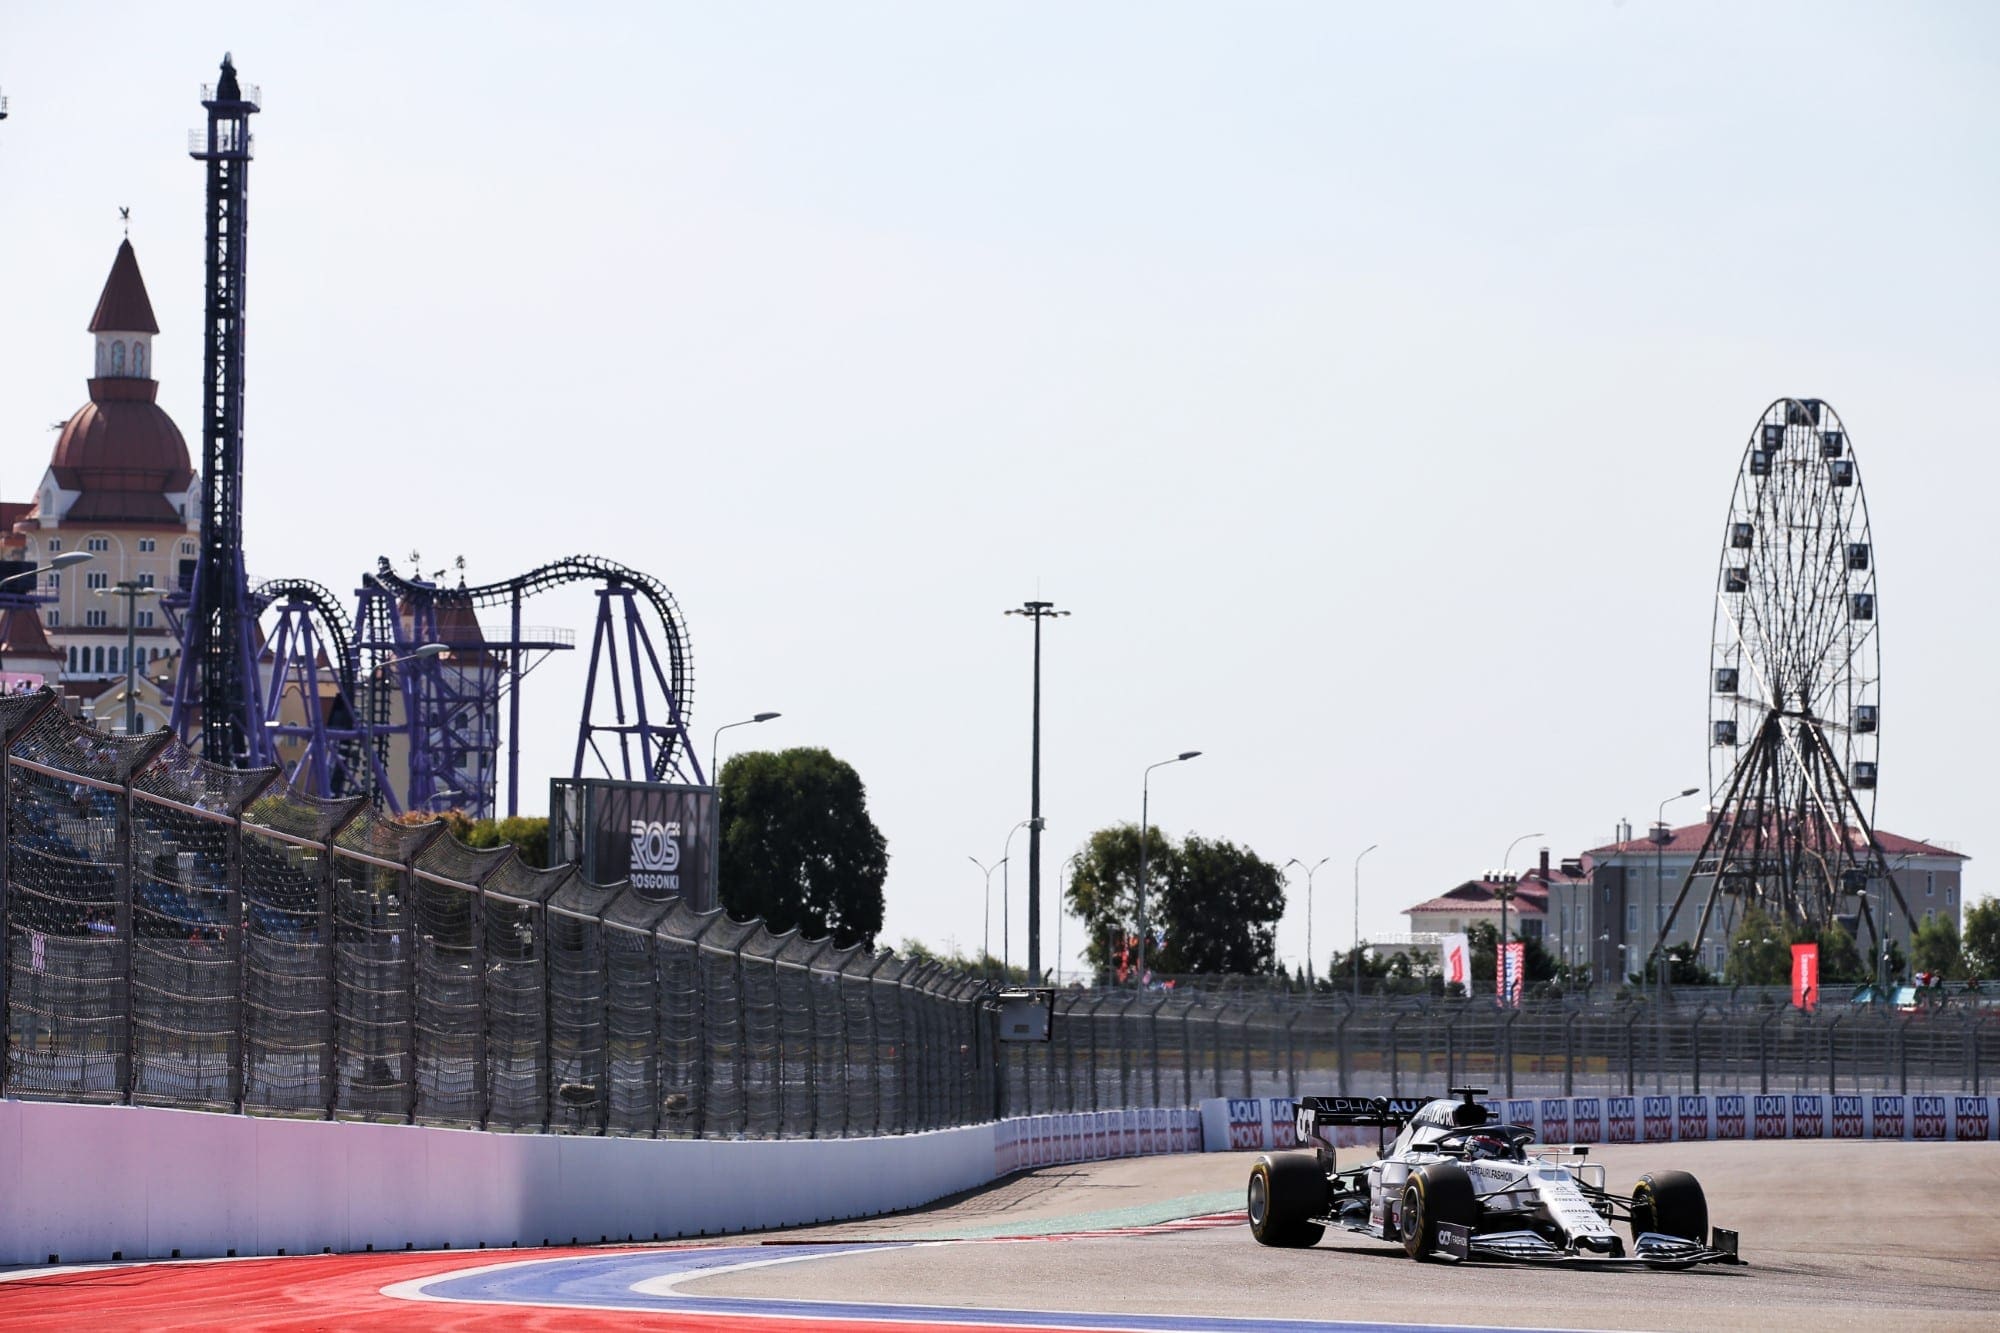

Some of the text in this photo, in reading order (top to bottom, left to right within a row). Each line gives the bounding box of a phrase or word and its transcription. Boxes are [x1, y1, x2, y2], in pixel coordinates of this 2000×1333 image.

[631, 820, 680, 871] ROS
[1229, 1101, 1261, 1121] LIQUI
[1543, 1102, 1567, 1120] LIQUI
[1574, 1101, 1599, 1120] LIQUI
[1608, 1100, 1634, 1118] LIQUI
[1645, 1100, 1671, 1117] LIQUI
[1680, 1099, 1706, 1117] LIQUI
[1717, 1099, 1744, 1116] LIQUI
[1755, 1098, 1784, 1115] LIQUI
[1794, 1098, 1822, 1115] LIQUI
[1833, 1099, 1862, 1115] LIQUI
[1874, 1099, 1903, 1115] LIQUI
[1915, 1099, 1944, 1116] LIQUI
[1956, 1100, 1987, 1116] LIQUI
[1230, 1126, 1263, 1147] MOLY
[1543, 1124, 1567, 1144] MOLY
[1575, 1122, 1600, 1142] MOLY
[1609, 1121, 1635, 1140] MOLY
[1646, 1119, 1672, 1139] MOLY
[1680, 1119, 1707, 1138] MOLY
[1717, 1119, 1744, 1138] MOLY
[1755, 1118, 1785, 1137] MOLY
[1794, 1118, 1823, 1137] MOLY
[1833, 1118, 1863, 1137] MOLY
[1874, 1118, 1904, 1137] MOLY
[1915, 1119, 1945, 1138] MOLY
[1956, 1119, 1988, 1137] MOLY
